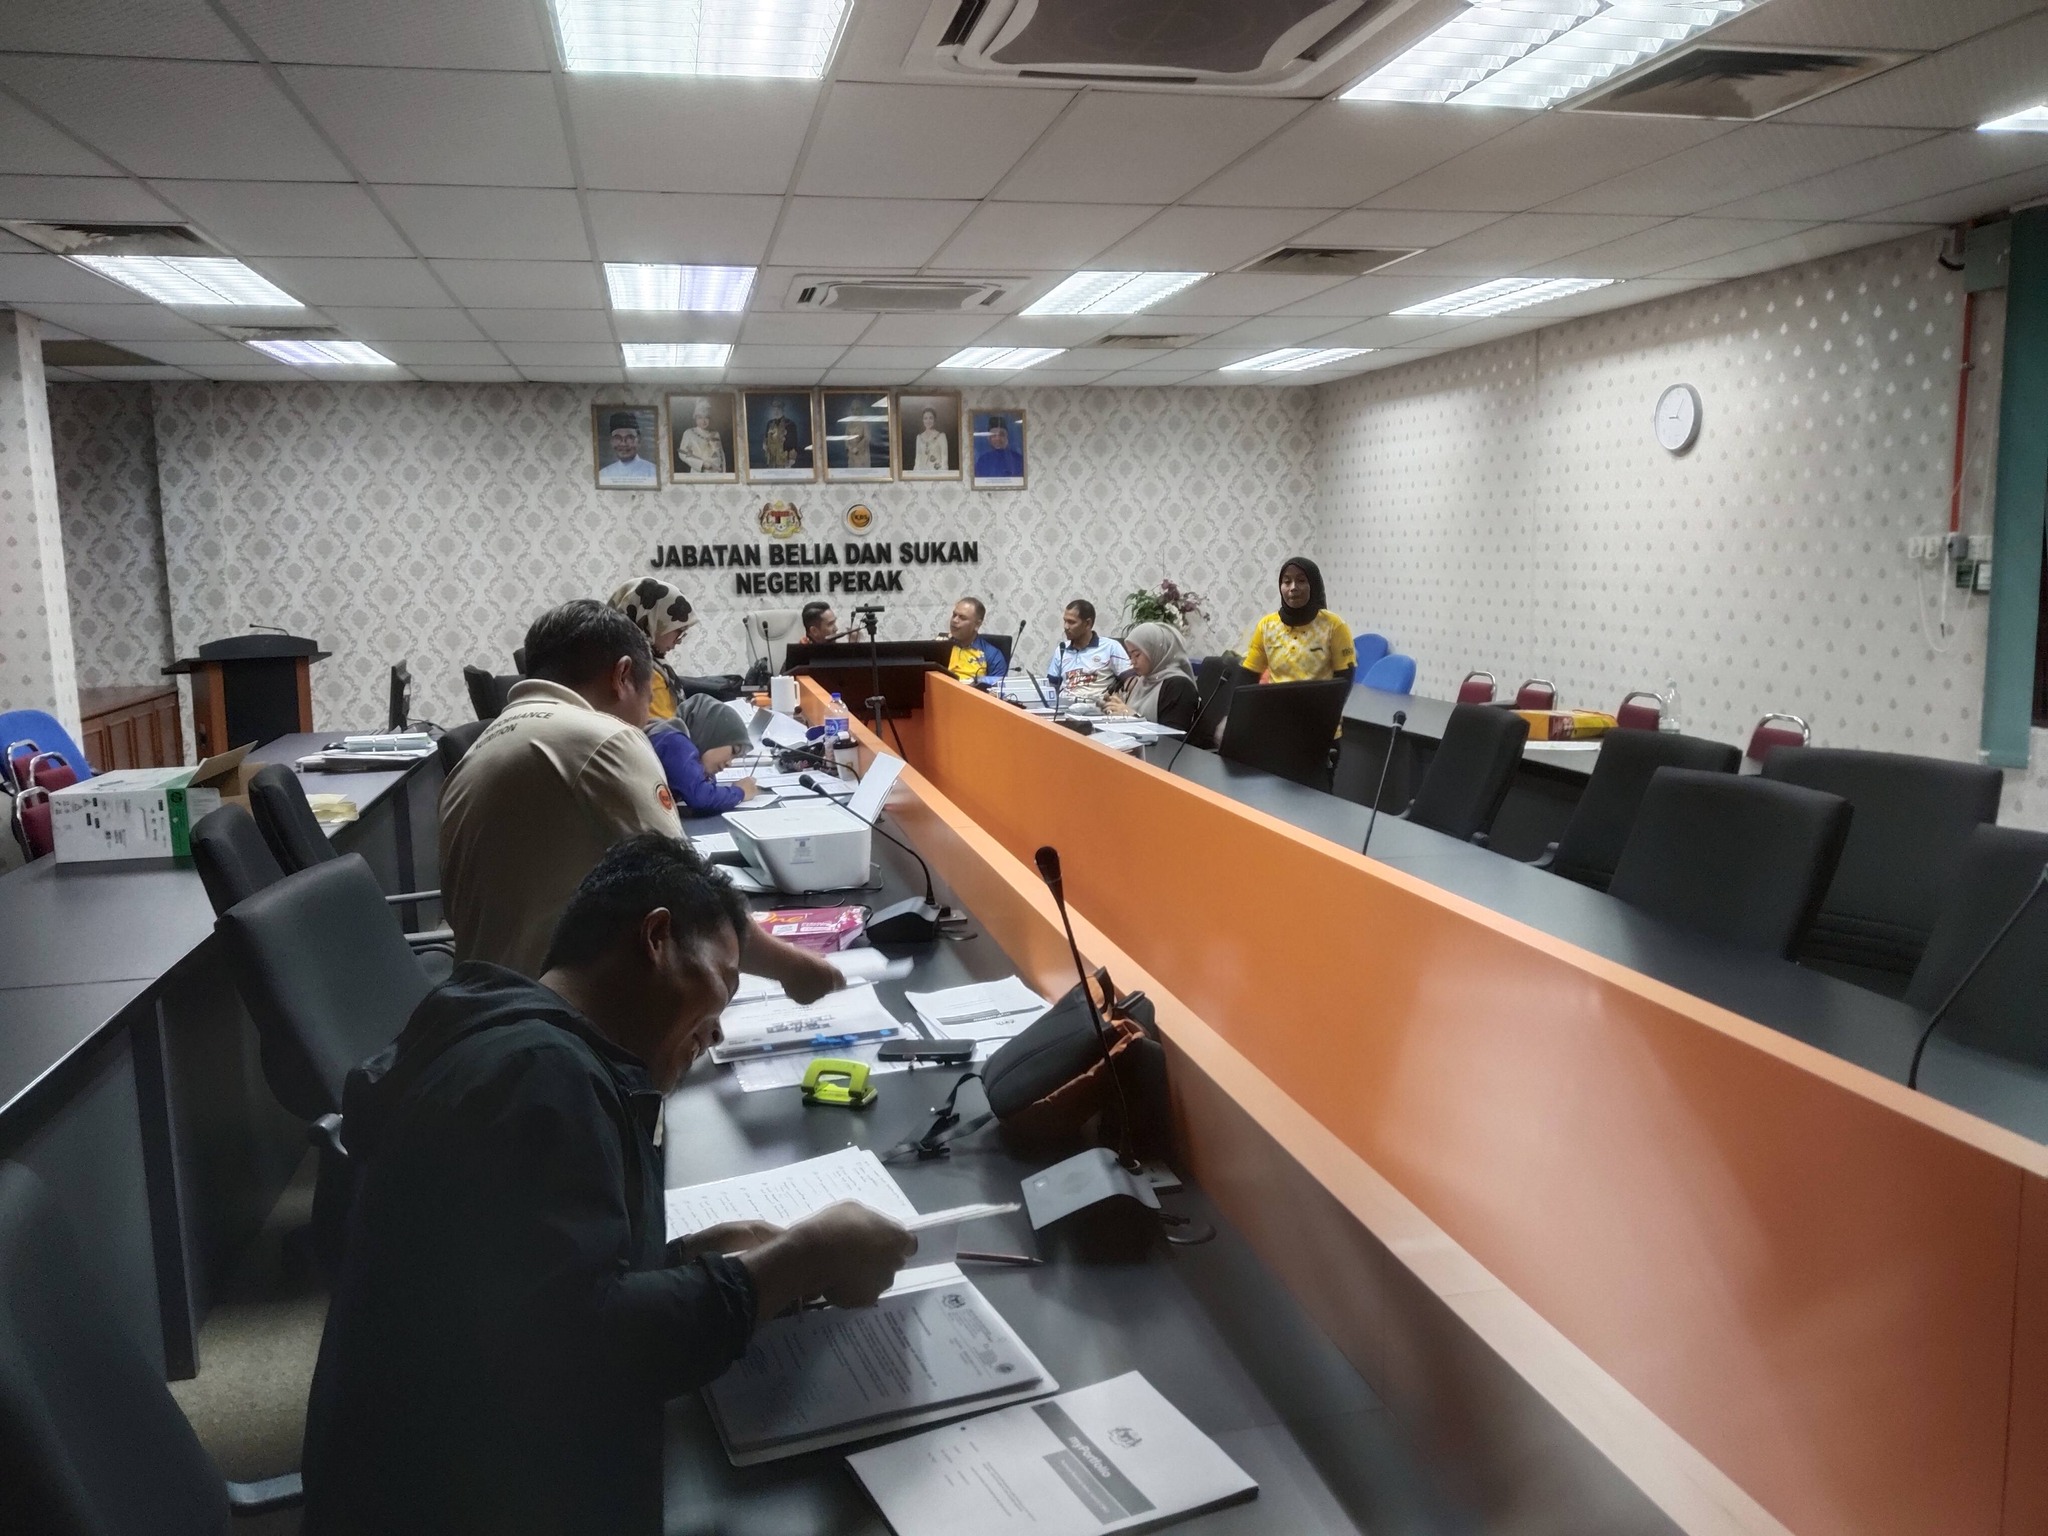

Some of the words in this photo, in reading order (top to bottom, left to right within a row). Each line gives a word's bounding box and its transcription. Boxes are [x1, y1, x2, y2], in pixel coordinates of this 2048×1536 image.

[650, 544, 761, 568] JABATAN
[768, 542, 838, 566] BELIA
[845, 542, 892, 565] DAN
[899, 541, 979, 564] SUKAN
[735, 571, 821, 594] NEGERI
[828, 570, 904, 593] PERAK
[1067, 1435, 1112, 1479] myPortfolio
